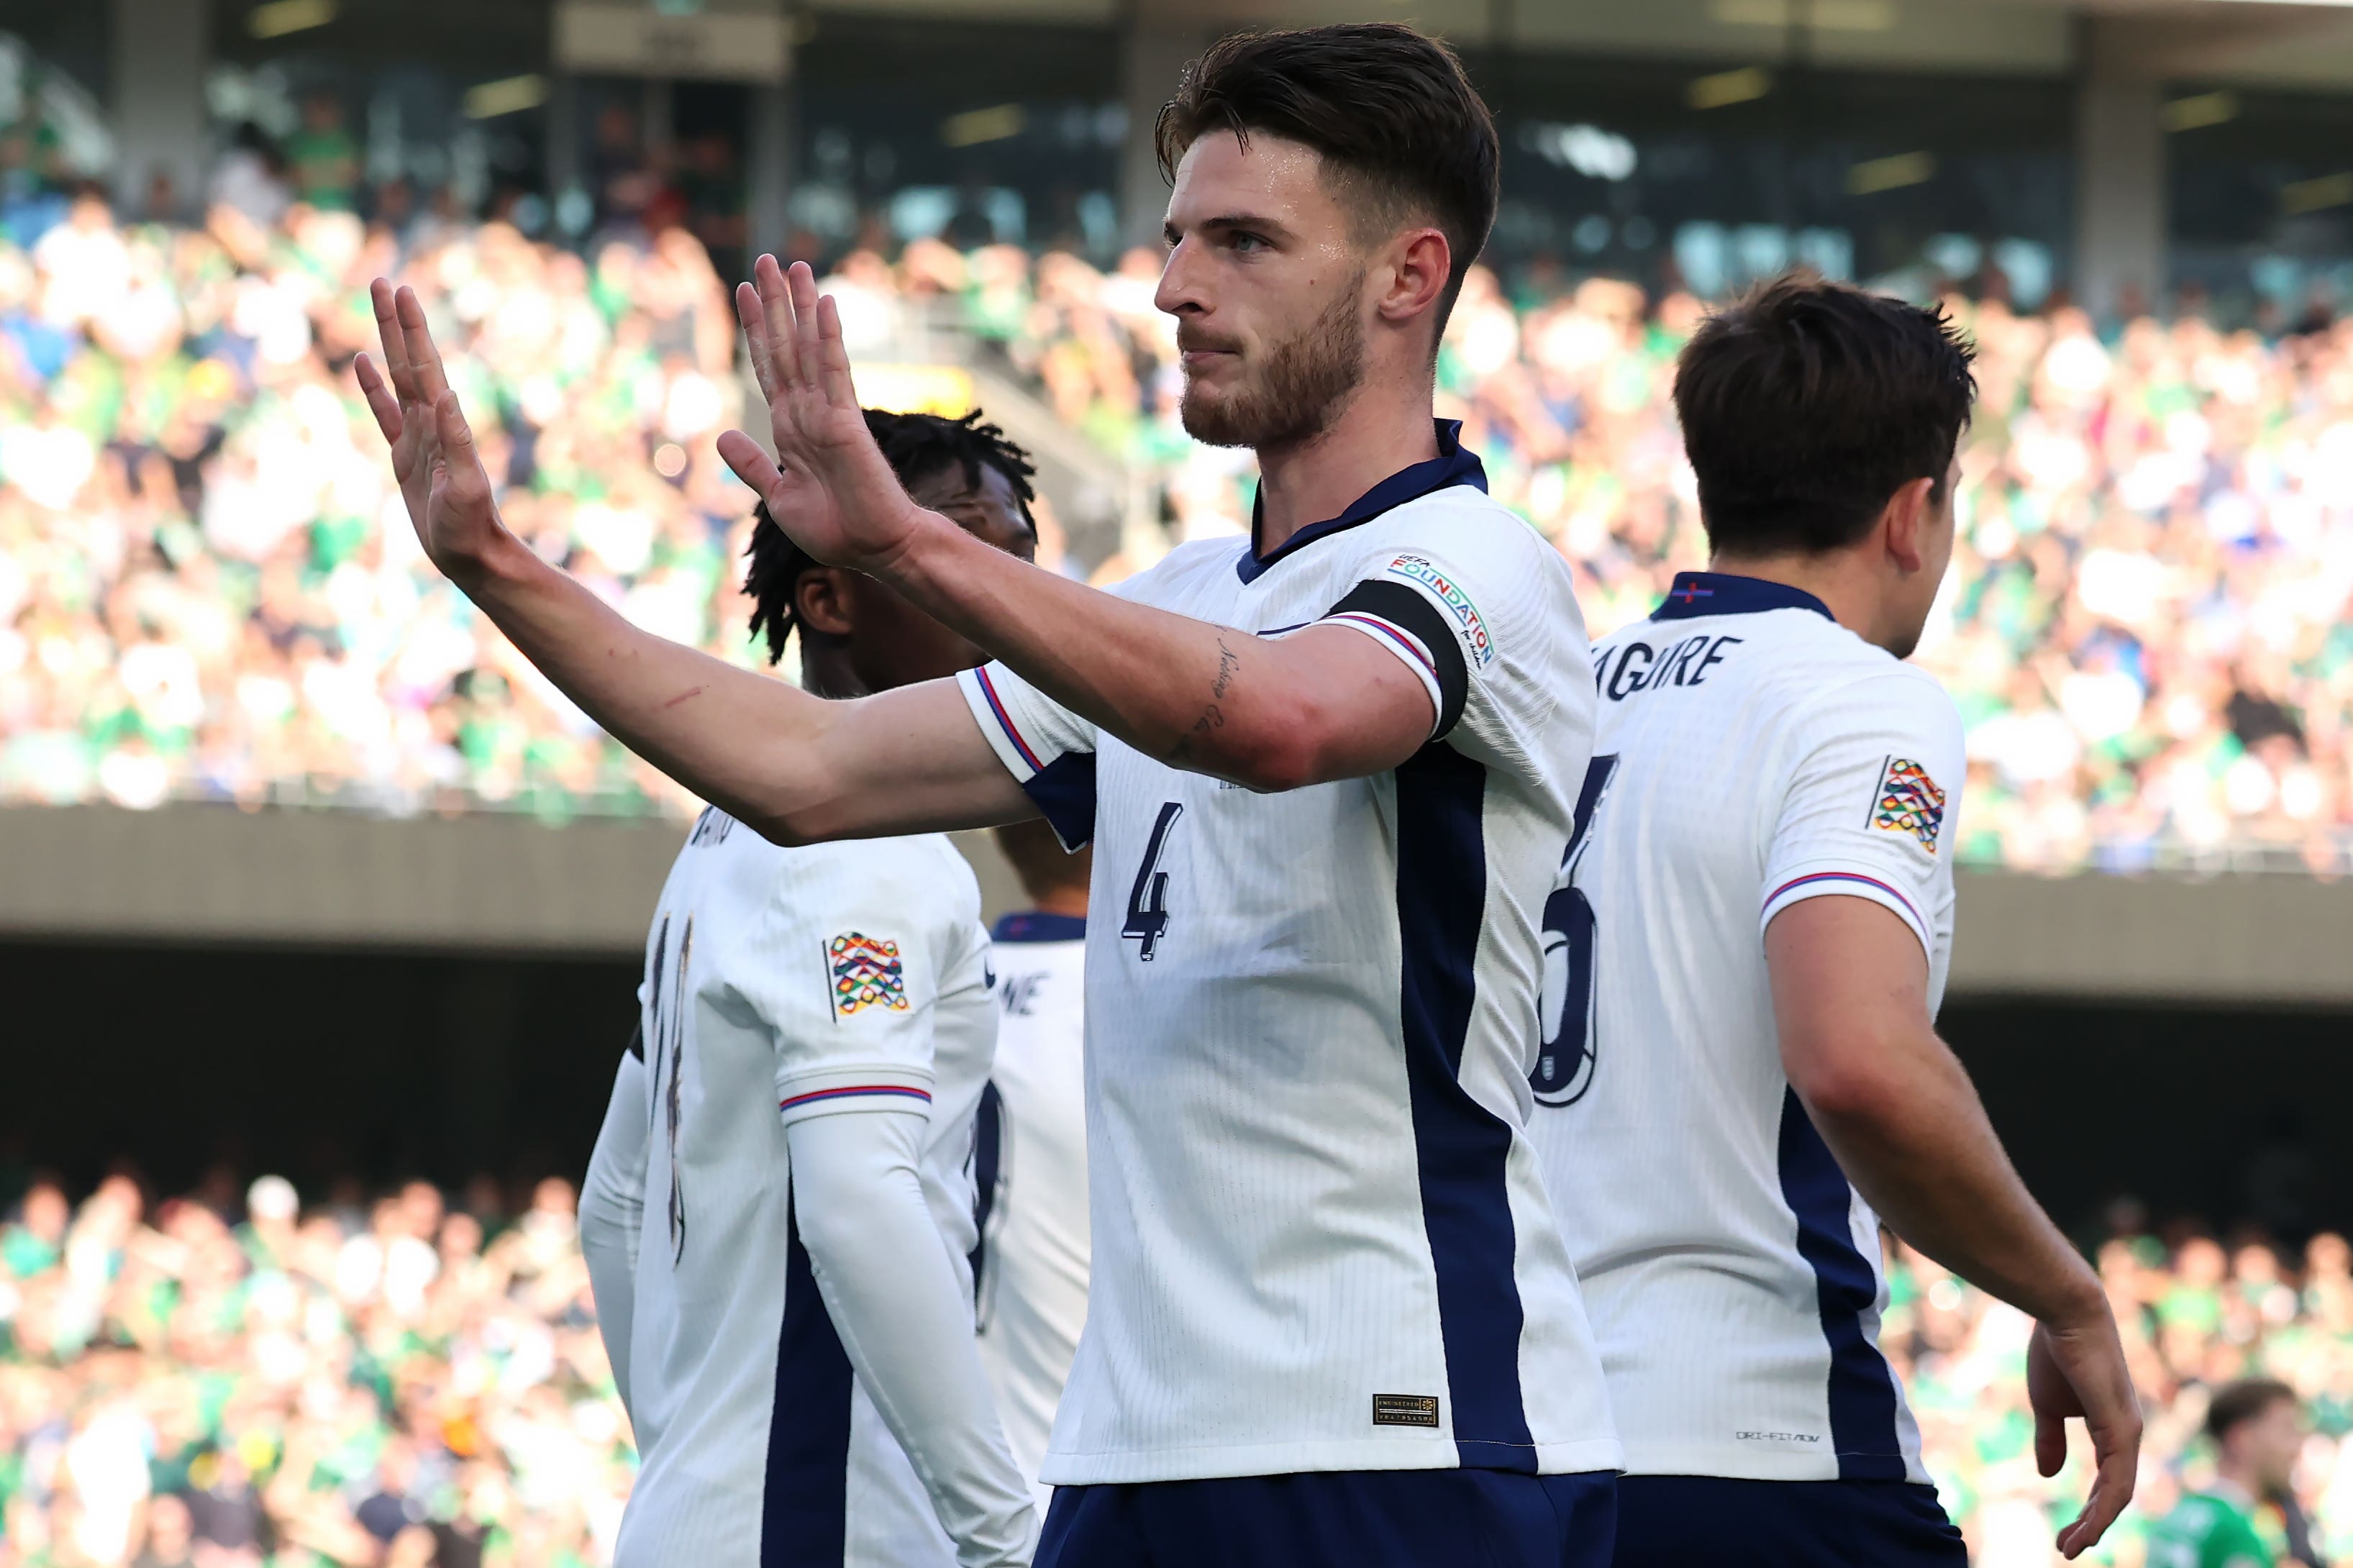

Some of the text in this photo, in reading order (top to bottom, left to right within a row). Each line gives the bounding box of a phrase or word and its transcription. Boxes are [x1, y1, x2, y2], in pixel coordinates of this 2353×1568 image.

[1398, 554, 1430, 568] UEFA
[1390, 559, 1493, 663] FOUNDATION
[1591, 636, 1744, 701] AGUIRE
[1121, 801, 1183, 961] 4
